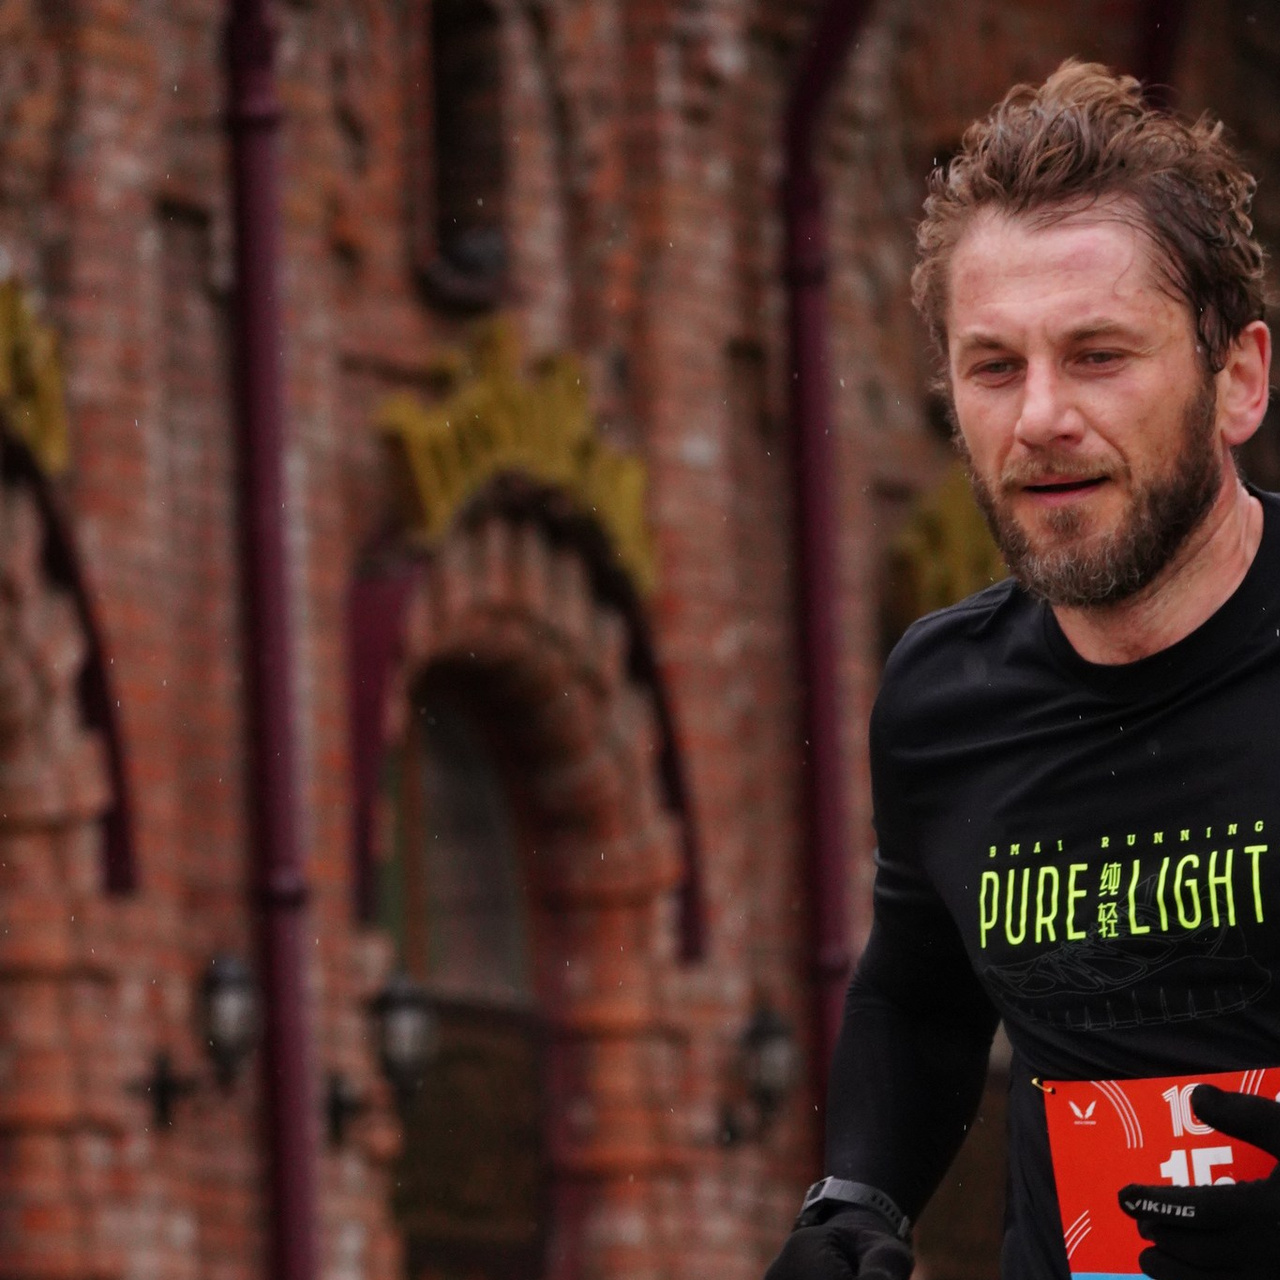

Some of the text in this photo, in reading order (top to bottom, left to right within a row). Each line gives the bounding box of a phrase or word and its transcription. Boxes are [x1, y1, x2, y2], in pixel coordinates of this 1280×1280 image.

[989, 820, 1264, 858] BMAI RUNNING
[980, 845, 1268, 949] PURE LIGHT
[1125, 1199, 1196, 1217] VIKING
